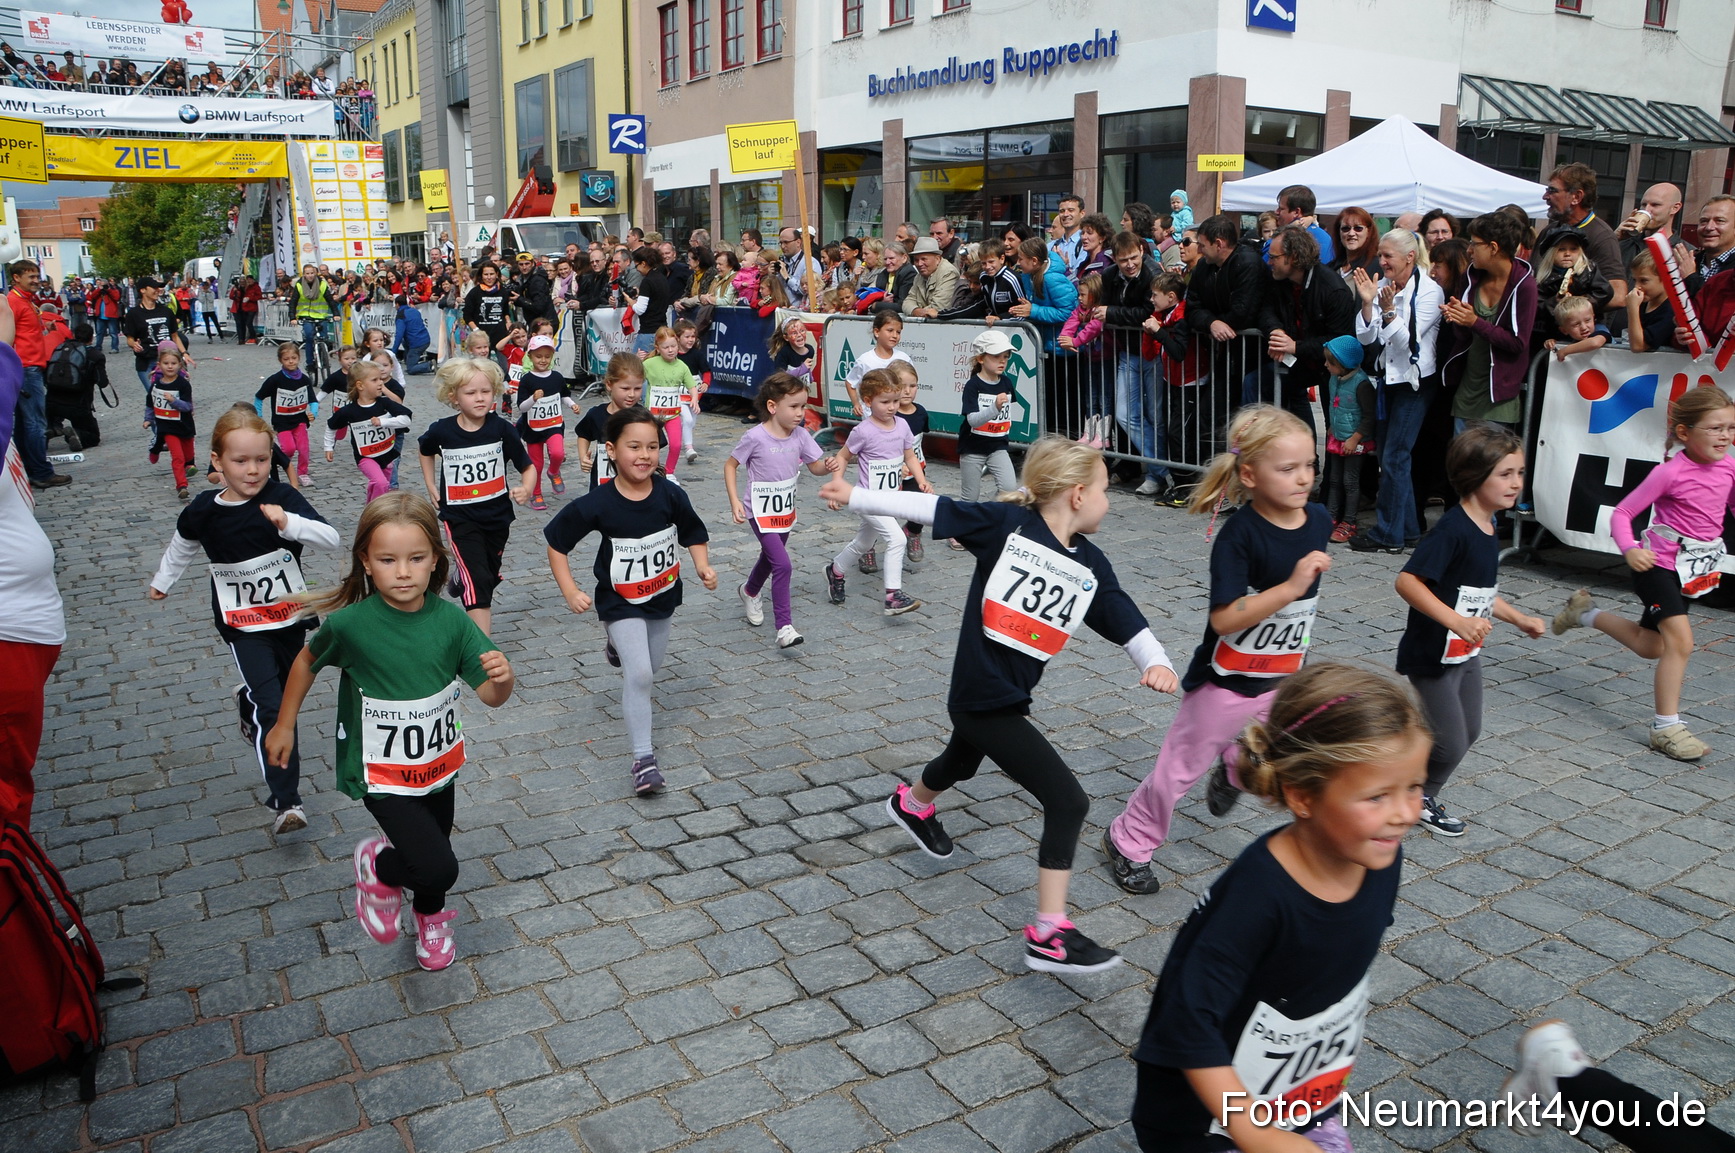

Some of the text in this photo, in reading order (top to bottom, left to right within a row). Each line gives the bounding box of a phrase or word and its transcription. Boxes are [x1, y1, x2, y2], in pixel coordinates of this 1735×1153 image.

[86, 21, 162, 35] LEBENSSPENDER
[105, 34, 147, 45] WERDEN!
[868, 28, 1118, 97] Buchhandlung Rupprecht
[32, 102, 107, 118] Laufsport
[205, 109, 305, 124] BMW Laufsport
[732, 136, 794, 149] Schnupper-
[114, 146, 181, 169] ZIEL
[754, 148, 774, 160] lauf
[1205, 159, 1237, 169] Infopoint
[706, 344, 758, 372] Fischer
[713, 371, 752, 387] AUTOMOBILE
[280, 394, 305, 407] 7212
[532, 403, 559, 419] 7340
[463, 450, 495, 460] Neumarkt
[449, 457, 498, 485] 7387
[614, 534, 673, 553] PARTL Neumarkt
[214, 559, 280, 578] PARTL Neumarkt
[620, 543, 675, 581] 7193
[1005, 544, 1081, 587] PARTL Neumarkt
[226, 569, 293, 608] 7221
[637, 576, 667, 595] Selina
[1001, 565, 1078, 628] 7324
[364, 697, 452, 721] PARTL Neumarkt
[376, 708, 457, 760] 7048
[401, 762, 446, 784] Vivien
[1250, 1021, 1311, 1046] PARTL
